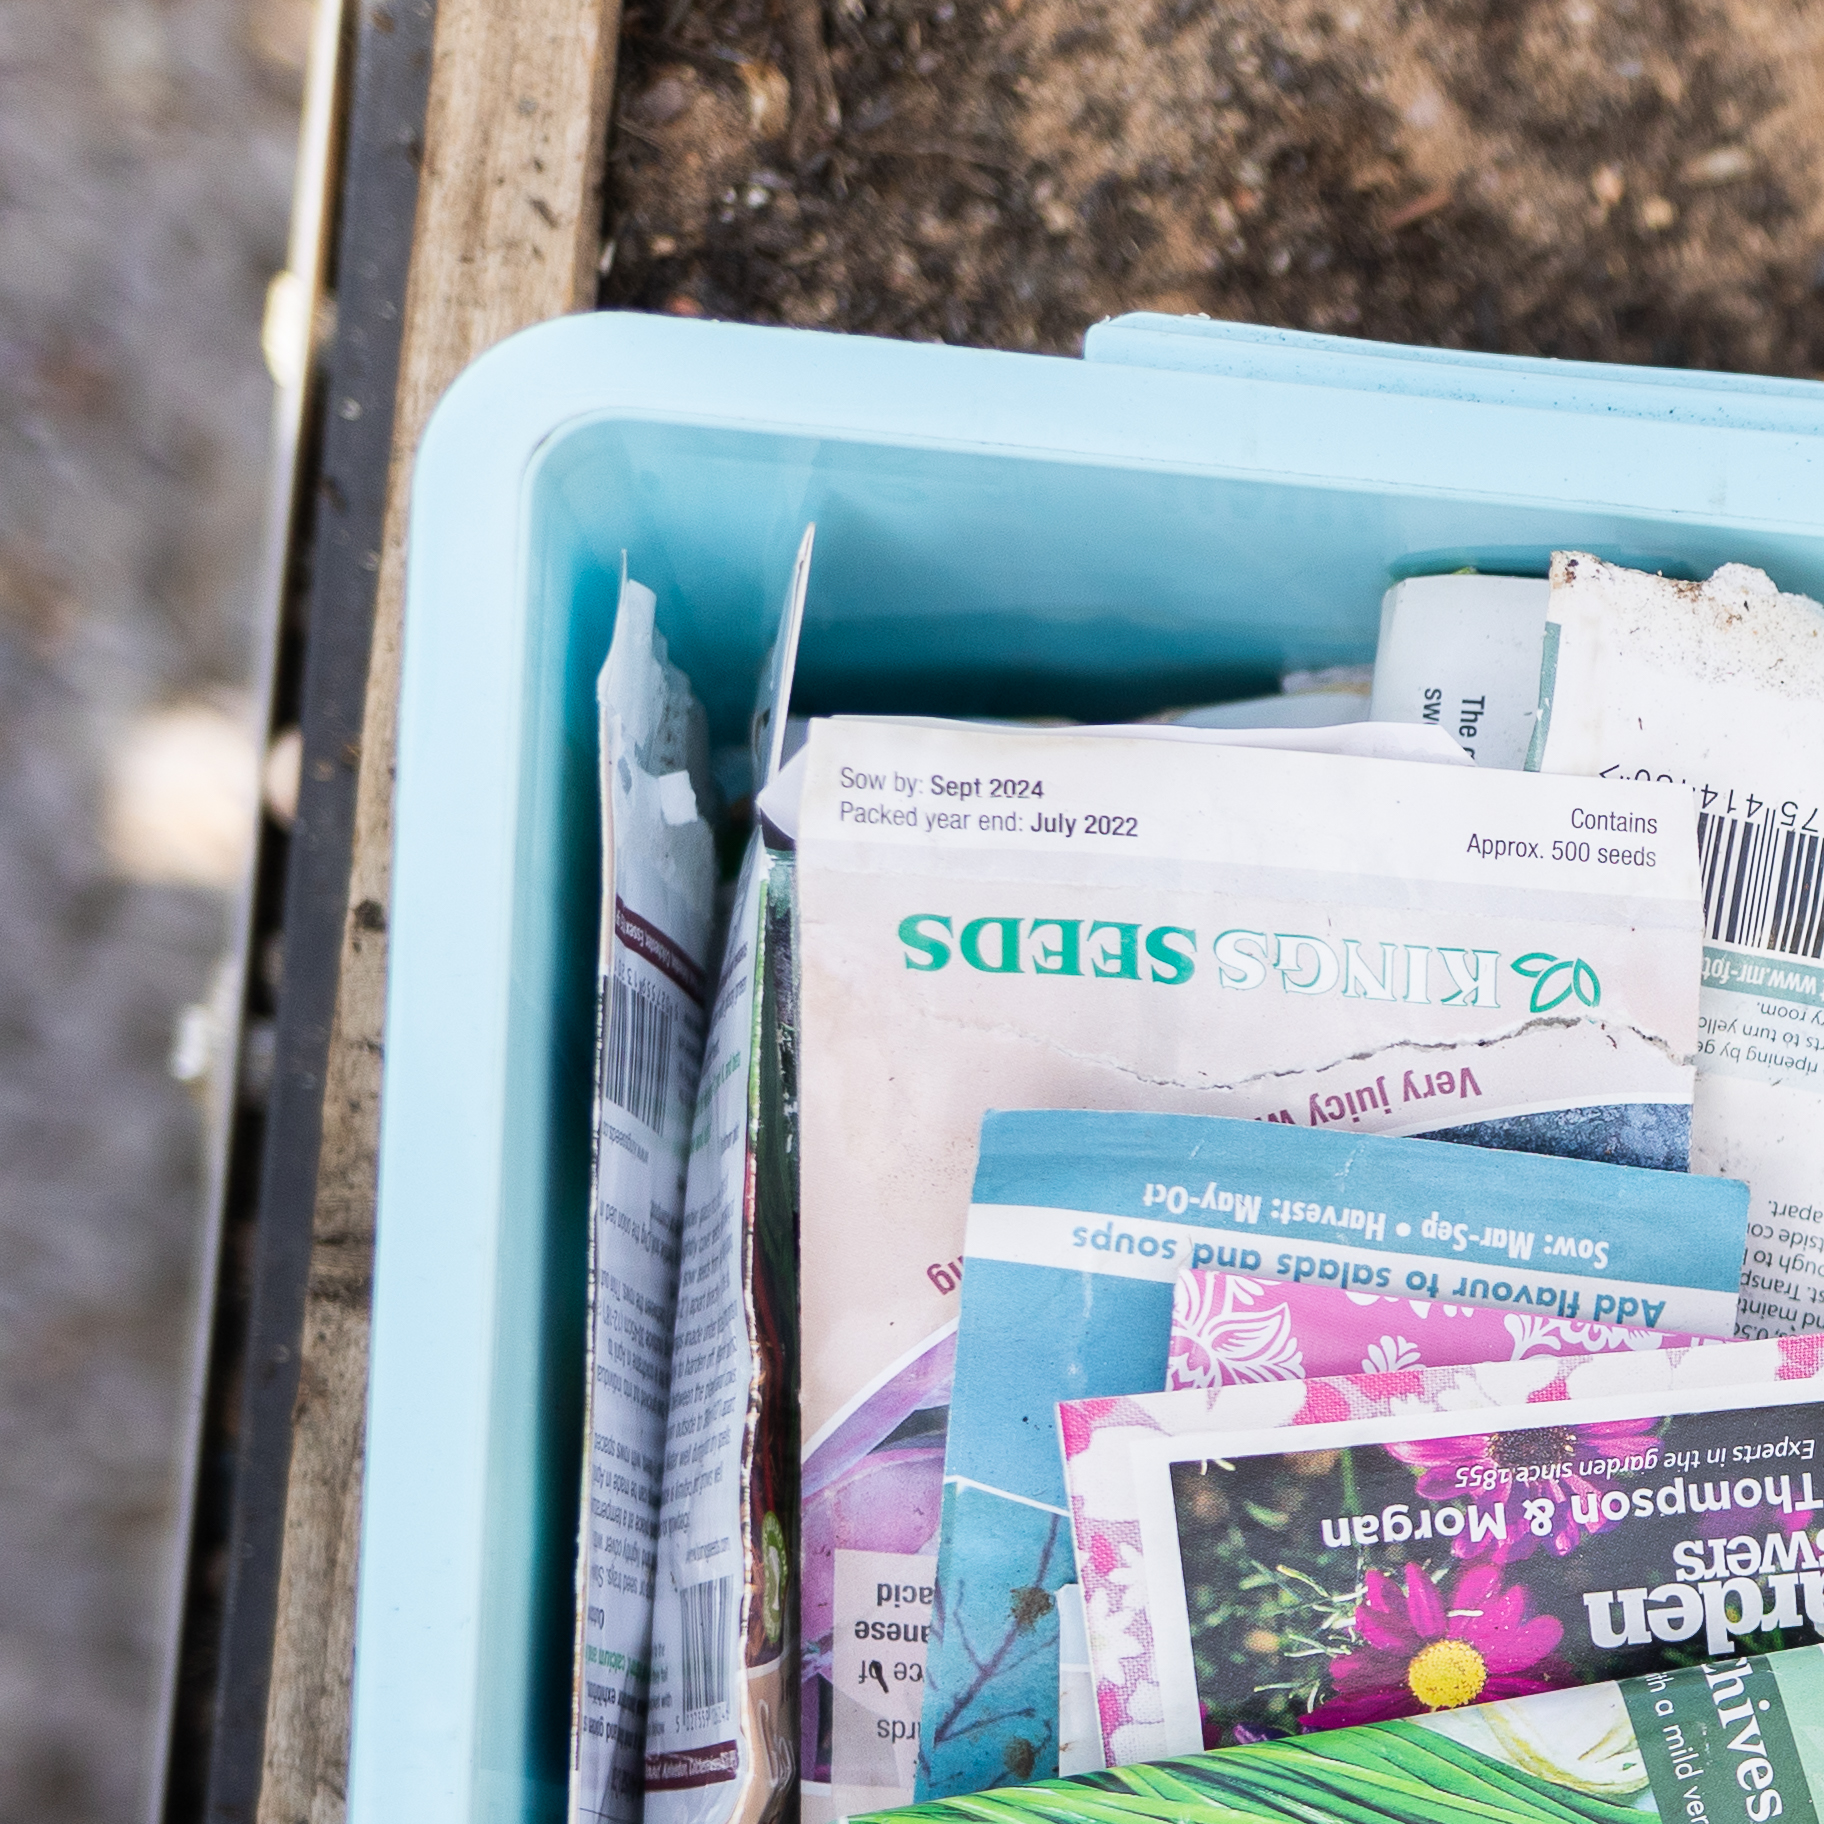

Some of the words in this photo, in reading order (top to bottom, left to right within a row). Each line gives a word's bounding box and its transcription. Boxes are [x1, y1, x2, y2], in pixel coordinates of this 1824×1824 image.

[1461, 695, 1486, 739] The
[840, 767, 886, 792] Sow
[894, 770, 924, 797] by:
[931, 774, 983, 801] Sept
[990, 779, 1045, 799] 2024
[839, 801, 918, 827] Packed
[924, 809, 971, 833] year
[978, 812, 1023, 832] end:
[1030, 812, 1076, 837] July
[1085, 815, 1139, 837] 2022
[1570, 808, 1658, 834] Contains
[1466, 833, 1544, 860] Approx.
[1552, 841, 1590, 863] 500
[1597, 845, 1657, 867] seeds
[898, 913, 1197, 985] SEEDS
[1213, 929, 1501, 1008] KINGS
[1755, 1001, 1807, 1023] room.
[1742, 1024, 1777, 1042] turn
[1719, 1041, 1741, 1063] by
[1745, 1045, 1818, 1076] ripening
[1309, 1076, 1389, 1128] juicy
[1403, 1067, 1482, 1104] Very
[1142, 1176, 1262, 1223] May-Oct
[1767, 1199, 1824, 1224] apart.
[1268, 1195, 1386, 1240] Harvest:
[1421, 1211, 1535, 1258] Mar-Sep
[1072, 1221, 1178, 1260] soups
[1542, 1233, 1610, 1268] Sow:
[1753, 1250, 1774, 1266] to
[1190, 1239, 1262, 1279] and
[1274, 1249, 1393, 1291] salads
[1405, 1267, 1442, 1299] to
[1451, 1272, 1583, 1319] flavour
[1611, 1294, 1666, 1329] Add
[1579, 1446, 1659, 1480] garden
[1663, 1449, 1701, 1473] the
[1706, 1447, 1727, 1468] in
[1732, 1435, 1815, 1464] Experts
[1453, 1462, 1510, 1489] 1855
[1513, 1460, 1574, 1486] since
[1519, 1497, 1554, 1536] &
[1570, 1470, 1823, 1531] Thompson
[1320, 1500, 1508, 1554] Morgan
[1662, 1724, 1701, 1780] mild
